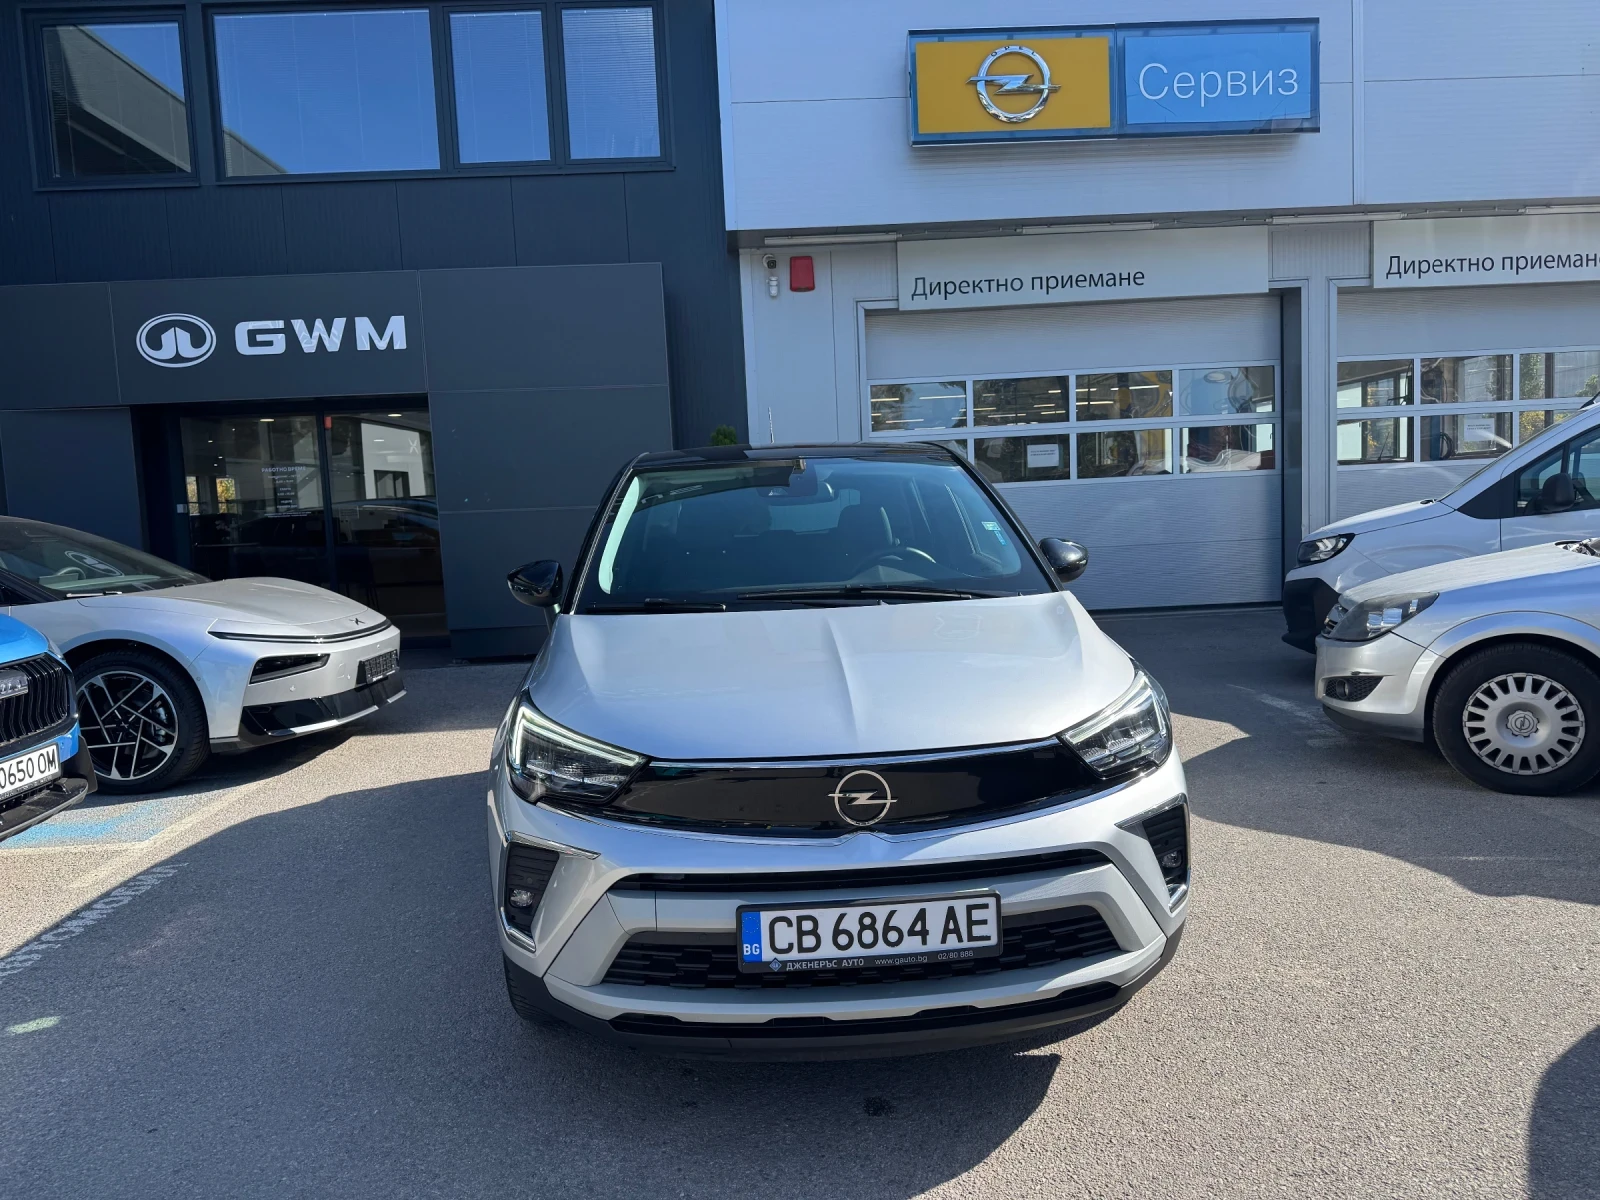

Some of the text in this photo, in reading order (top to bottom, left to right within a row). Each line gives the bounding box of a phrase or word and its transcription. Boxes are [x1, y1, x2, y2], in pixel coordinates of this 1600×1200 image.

[990, 45, 1037, 57] OPEL
[1138, 62, 1299, 107] Сервиз
[1385, 252, 1600, 280] Директно приеман
[911, 269, 1145, 301] Директно приемане
[234, 315, 407, 356] GWM
[37, 748, 57, 775] OM
[768, 903, 992, 955] CB 6864 AE
[743, 943, 760, 956] BG
[874, 954, 928, 965] www.gauto.bg
[786, 959, 838, 971] ДЖЕНЕРЪС
[841, 958, 864, 968] АУТО
